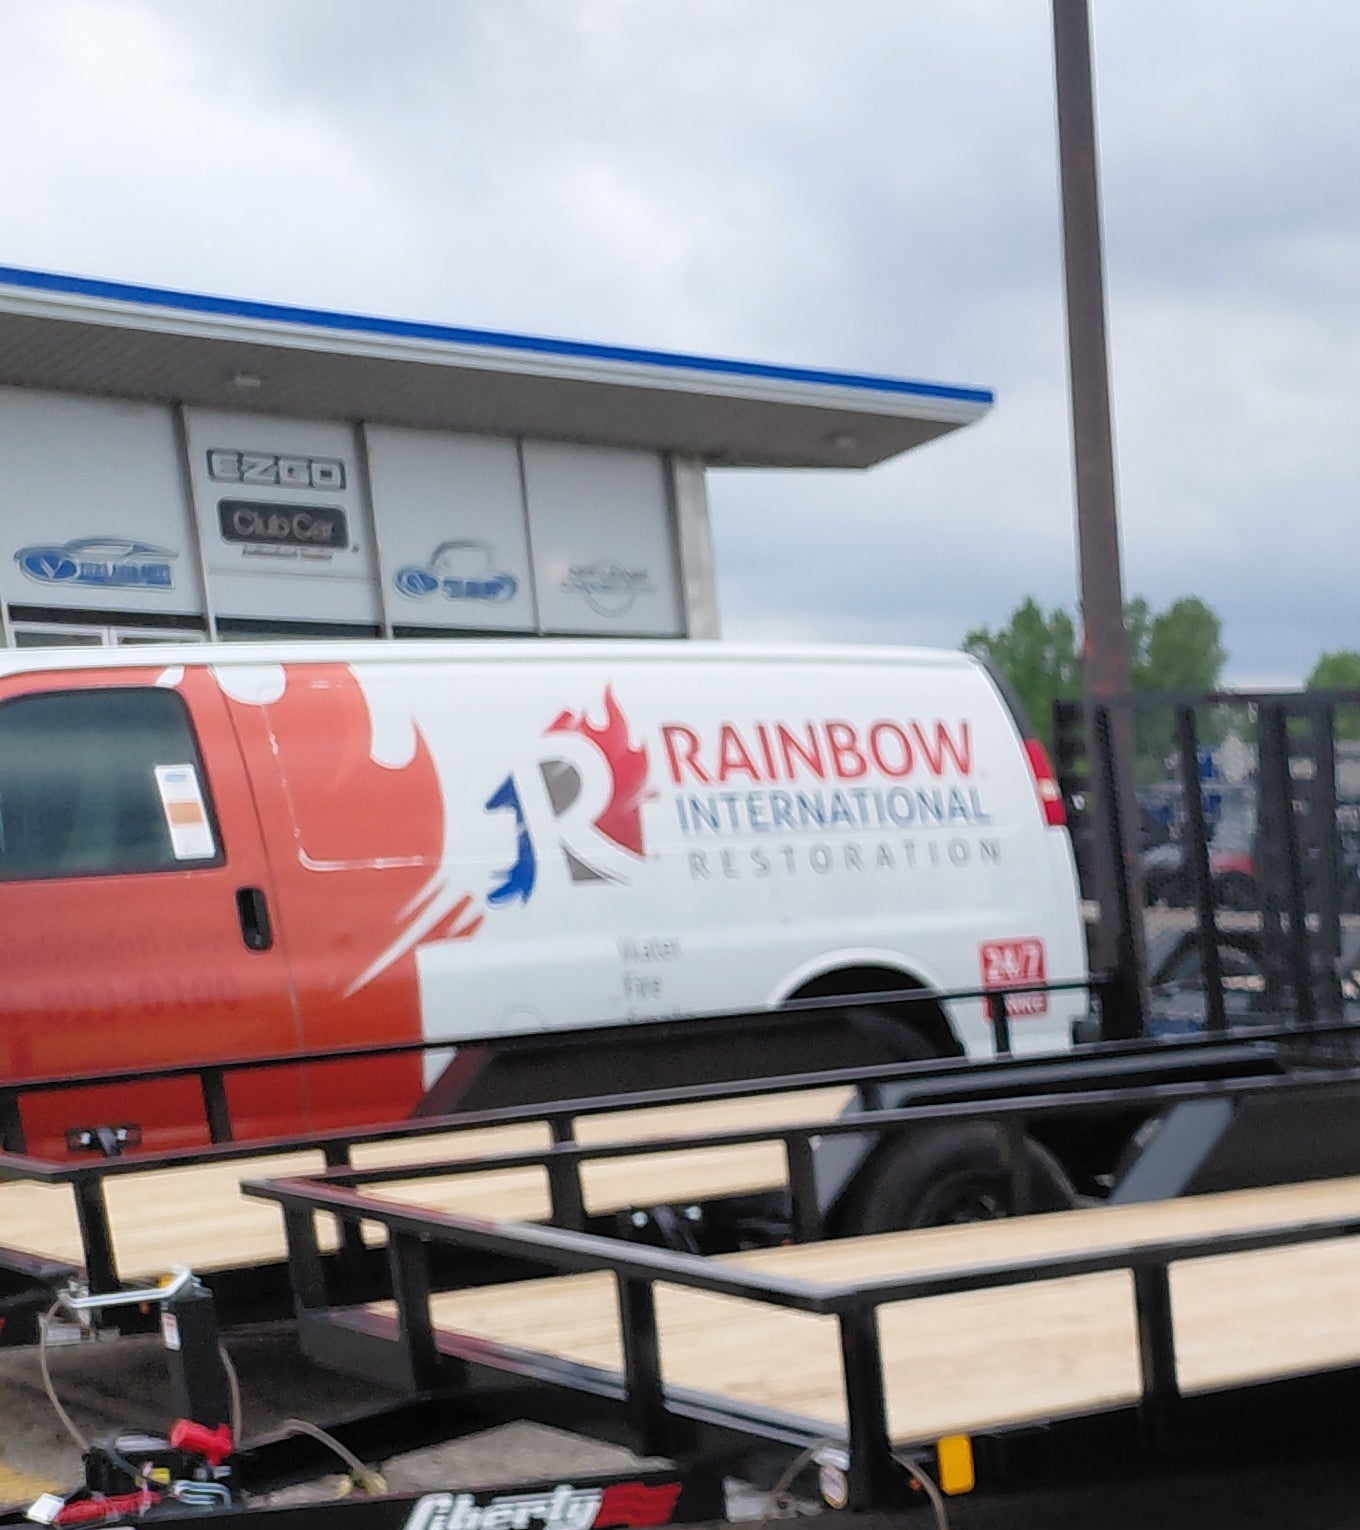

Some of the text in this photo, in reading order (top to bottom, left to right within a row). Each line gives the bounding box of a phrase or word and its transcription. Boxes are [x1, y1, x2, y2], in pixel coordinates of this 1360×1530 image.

[233, 508, 335, 543] Club Car
[661, 719, 973, 786] RAINBOW
[676, 786, 991, 835] INTERNATIONAL
[688, 838, 1001, 881] RESTORATION
